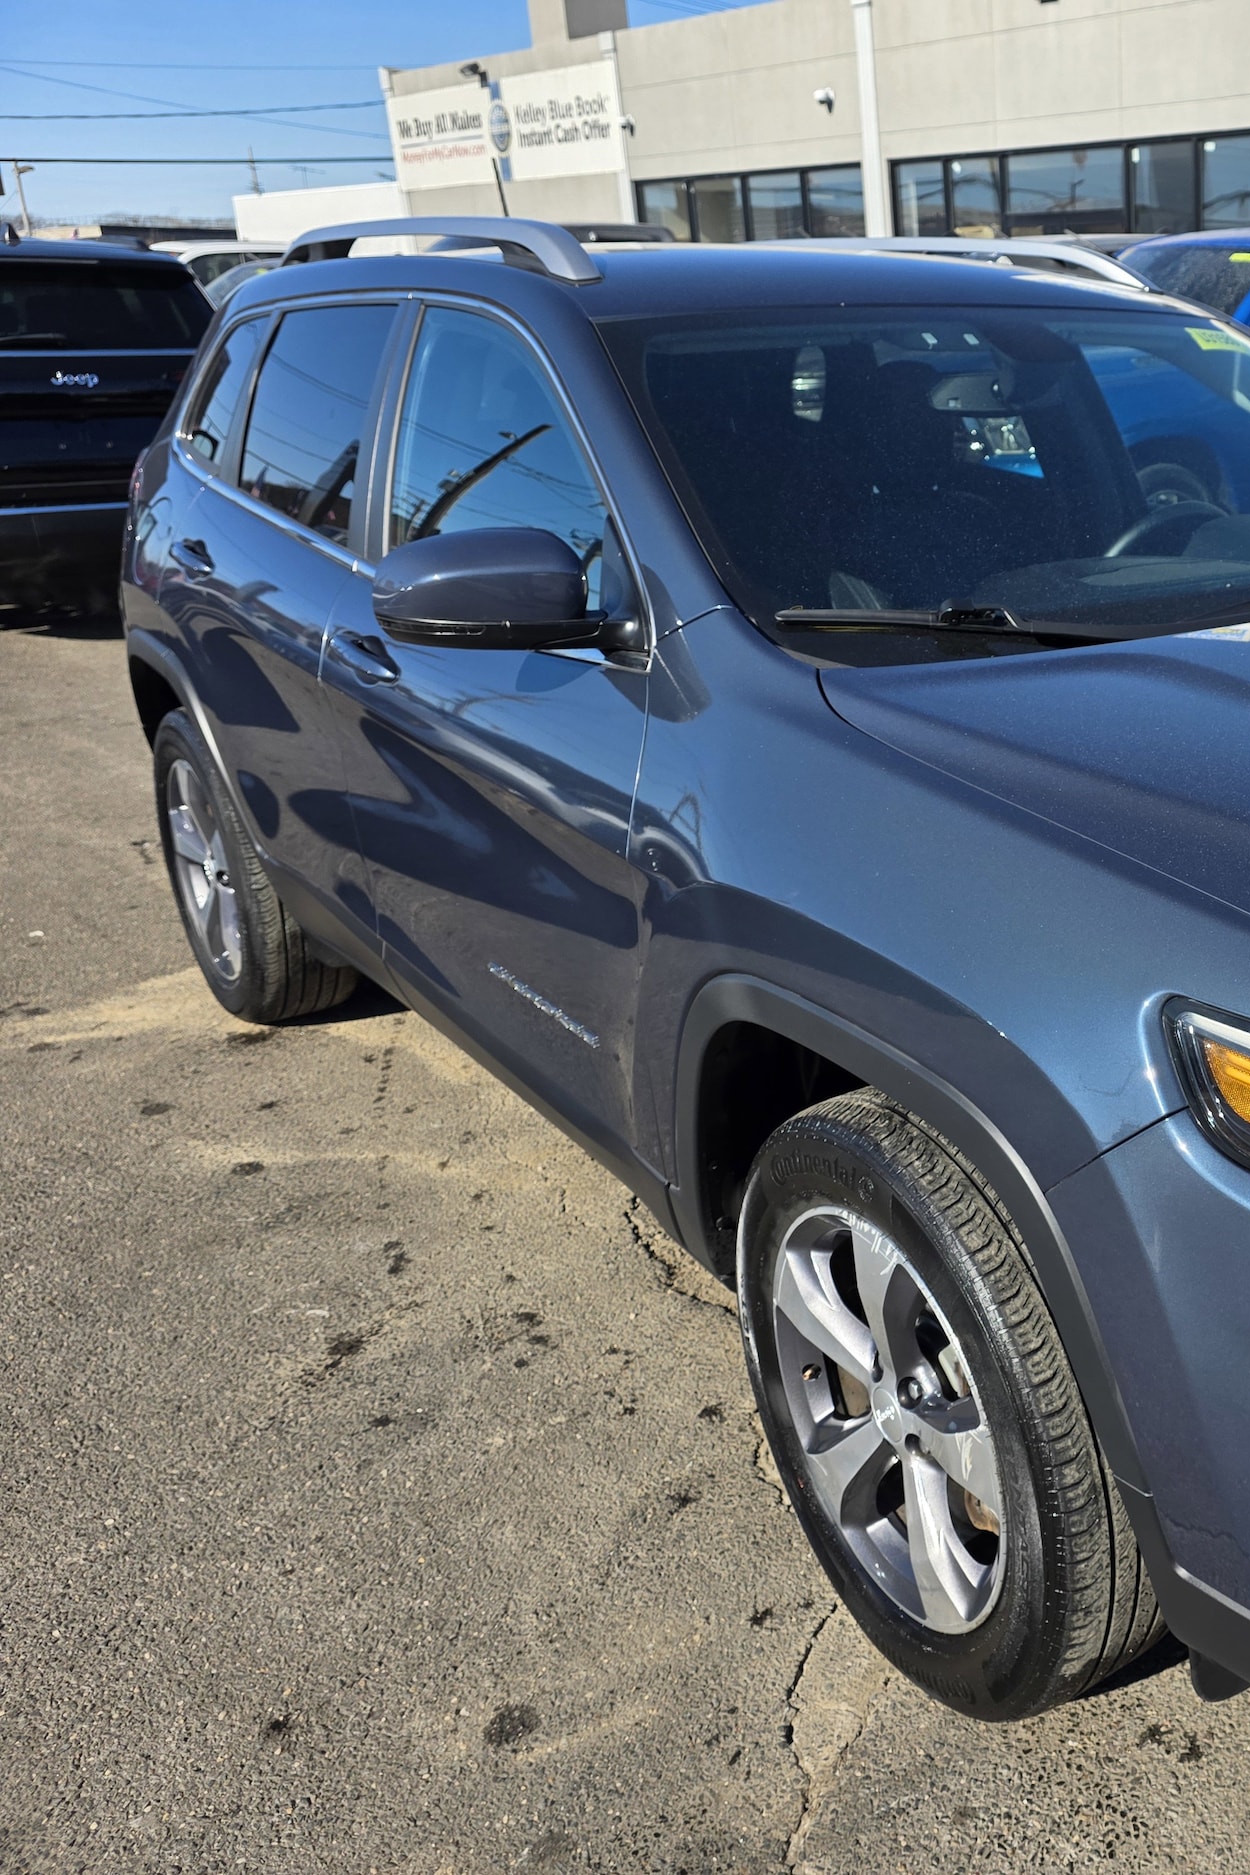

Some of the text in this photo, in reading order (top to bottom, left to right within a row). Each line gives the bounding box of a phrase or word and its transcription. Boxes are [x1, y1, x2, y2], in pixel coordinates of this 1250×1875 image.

[514, 92, 608, 125] Kelley Blue Book
[397, 119, 412, 139] We
[414, 117, 433, 141] Buy
[434, 113, 448, 133] All
[448, 110, 483, 131] Makes
[517, 128, 554, 148] Instant
[554, 121, 581, 142] Cash
[581, 118, 610, 140] Offer
[51, 371, 99, 388] Jeep
[770, 1149, 857, 1190] Continental
